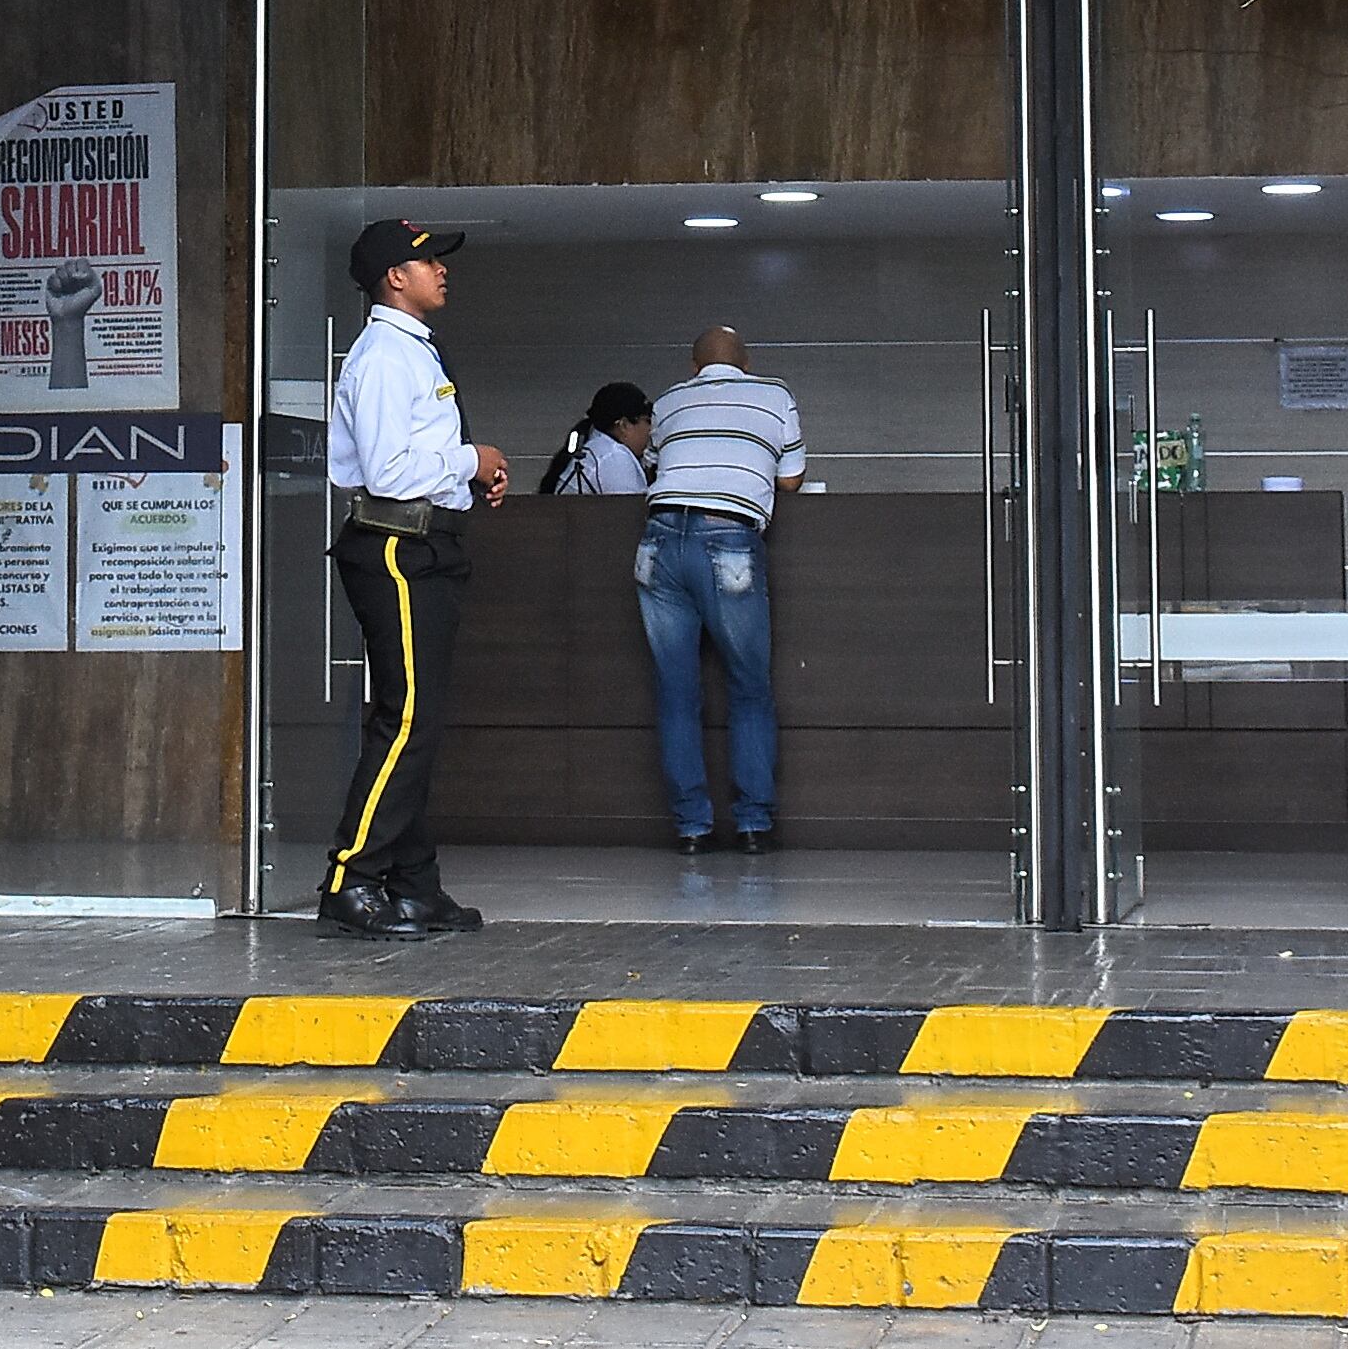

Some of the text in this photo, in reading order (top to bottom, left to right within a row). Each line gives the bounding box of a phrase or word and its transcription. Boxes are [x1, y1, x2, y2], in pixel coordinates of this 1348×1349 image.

[49, 100, 124, 121] USTED
[1, 182, 146, 259] SALARIAL
[101, 269, 162, 307] 19.87%
[1, 319, 50, 357] MESES
[92, 480, 126, 490] USTED
[24, 502, 39, 511] DE
[40, 502, 54, 511] LA
[102, 499, 215, 512] QUE SE CUMPLAN LOS
[130, 514, 188, 524] ACUERDOS
[92, 542, 137, 555] Exigimos
[173, 541, 213, 553] impulse
[4, 558, 50, 568] personas
[101, 556, 175, 568] recomposición
[43, 572, 50, 582] y
[138, 570, 162, 580] todo
[175, 572, 195, 582] que
[32, 583, 46, 593] DE
[148, 625, 181, 636] básica
